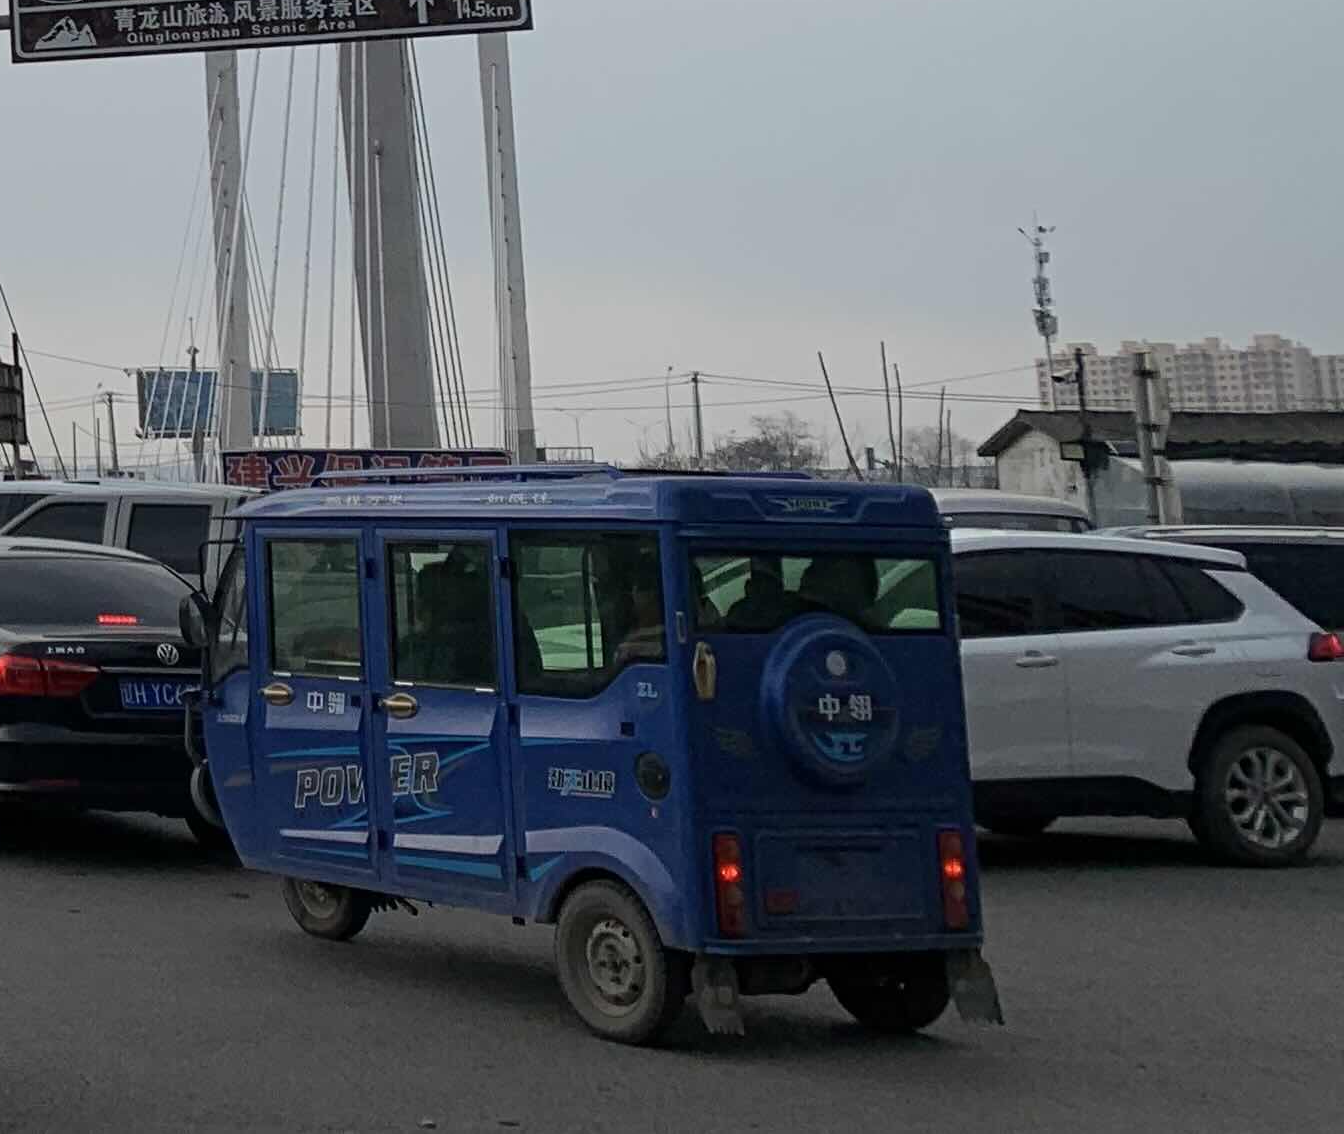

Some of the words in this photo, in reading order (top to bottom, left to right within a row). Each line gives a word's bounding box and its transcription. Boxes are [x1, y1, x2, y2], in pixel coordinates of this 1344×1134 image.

[127, 26, 240, 44] Qinglongshan
[251, 22, 306, 36] Scenic
[318, 18, 356, 31] Area
